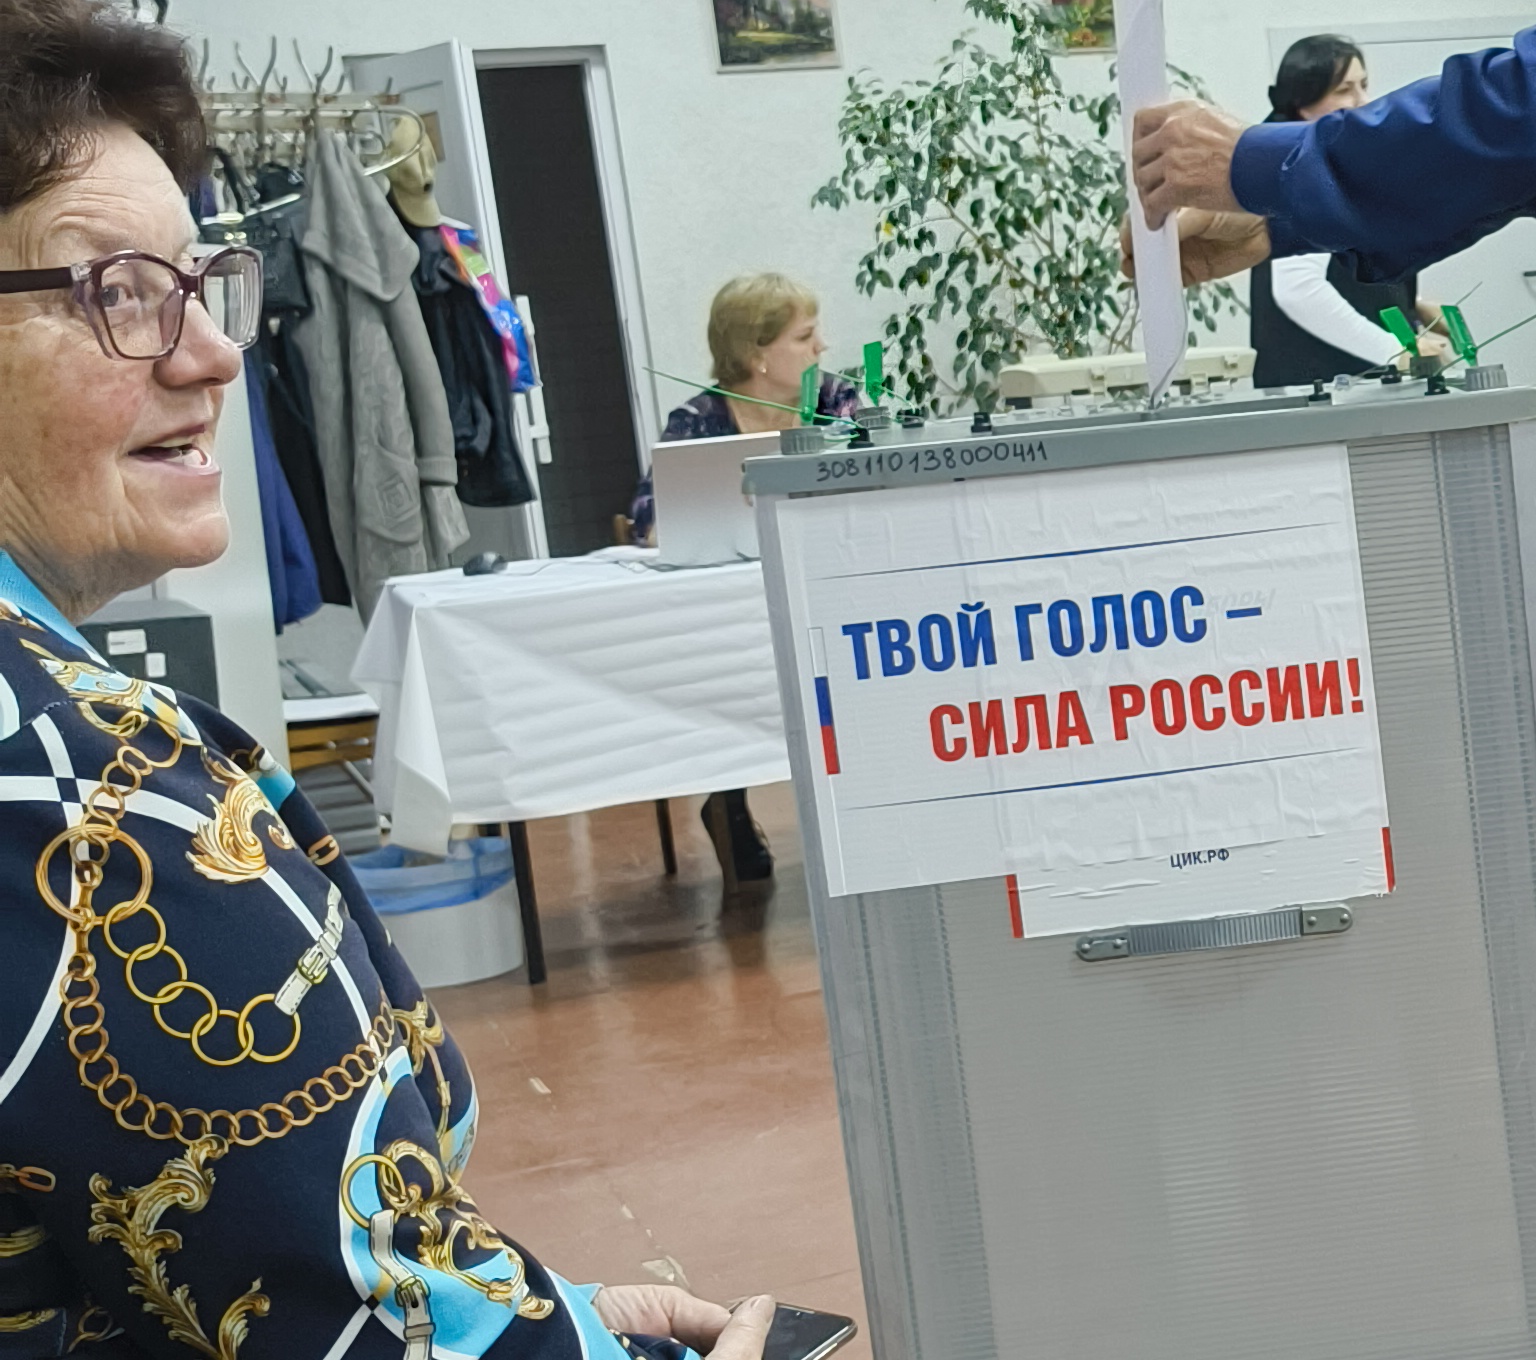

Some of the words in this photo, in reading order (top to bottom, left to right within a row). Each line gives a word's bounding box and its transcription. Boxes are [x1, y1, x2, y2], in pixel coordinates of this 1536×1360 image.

[841, 600, 999, 682] ТВОЙ
[1013, 585, 1207, 663] ГОЛОС
[928, 688, 1094, 763] СИЛА
[1108, 657, 1365, 742] РОССИИ!
[1170, 848, 1229, 870] ЦИК.РФ
